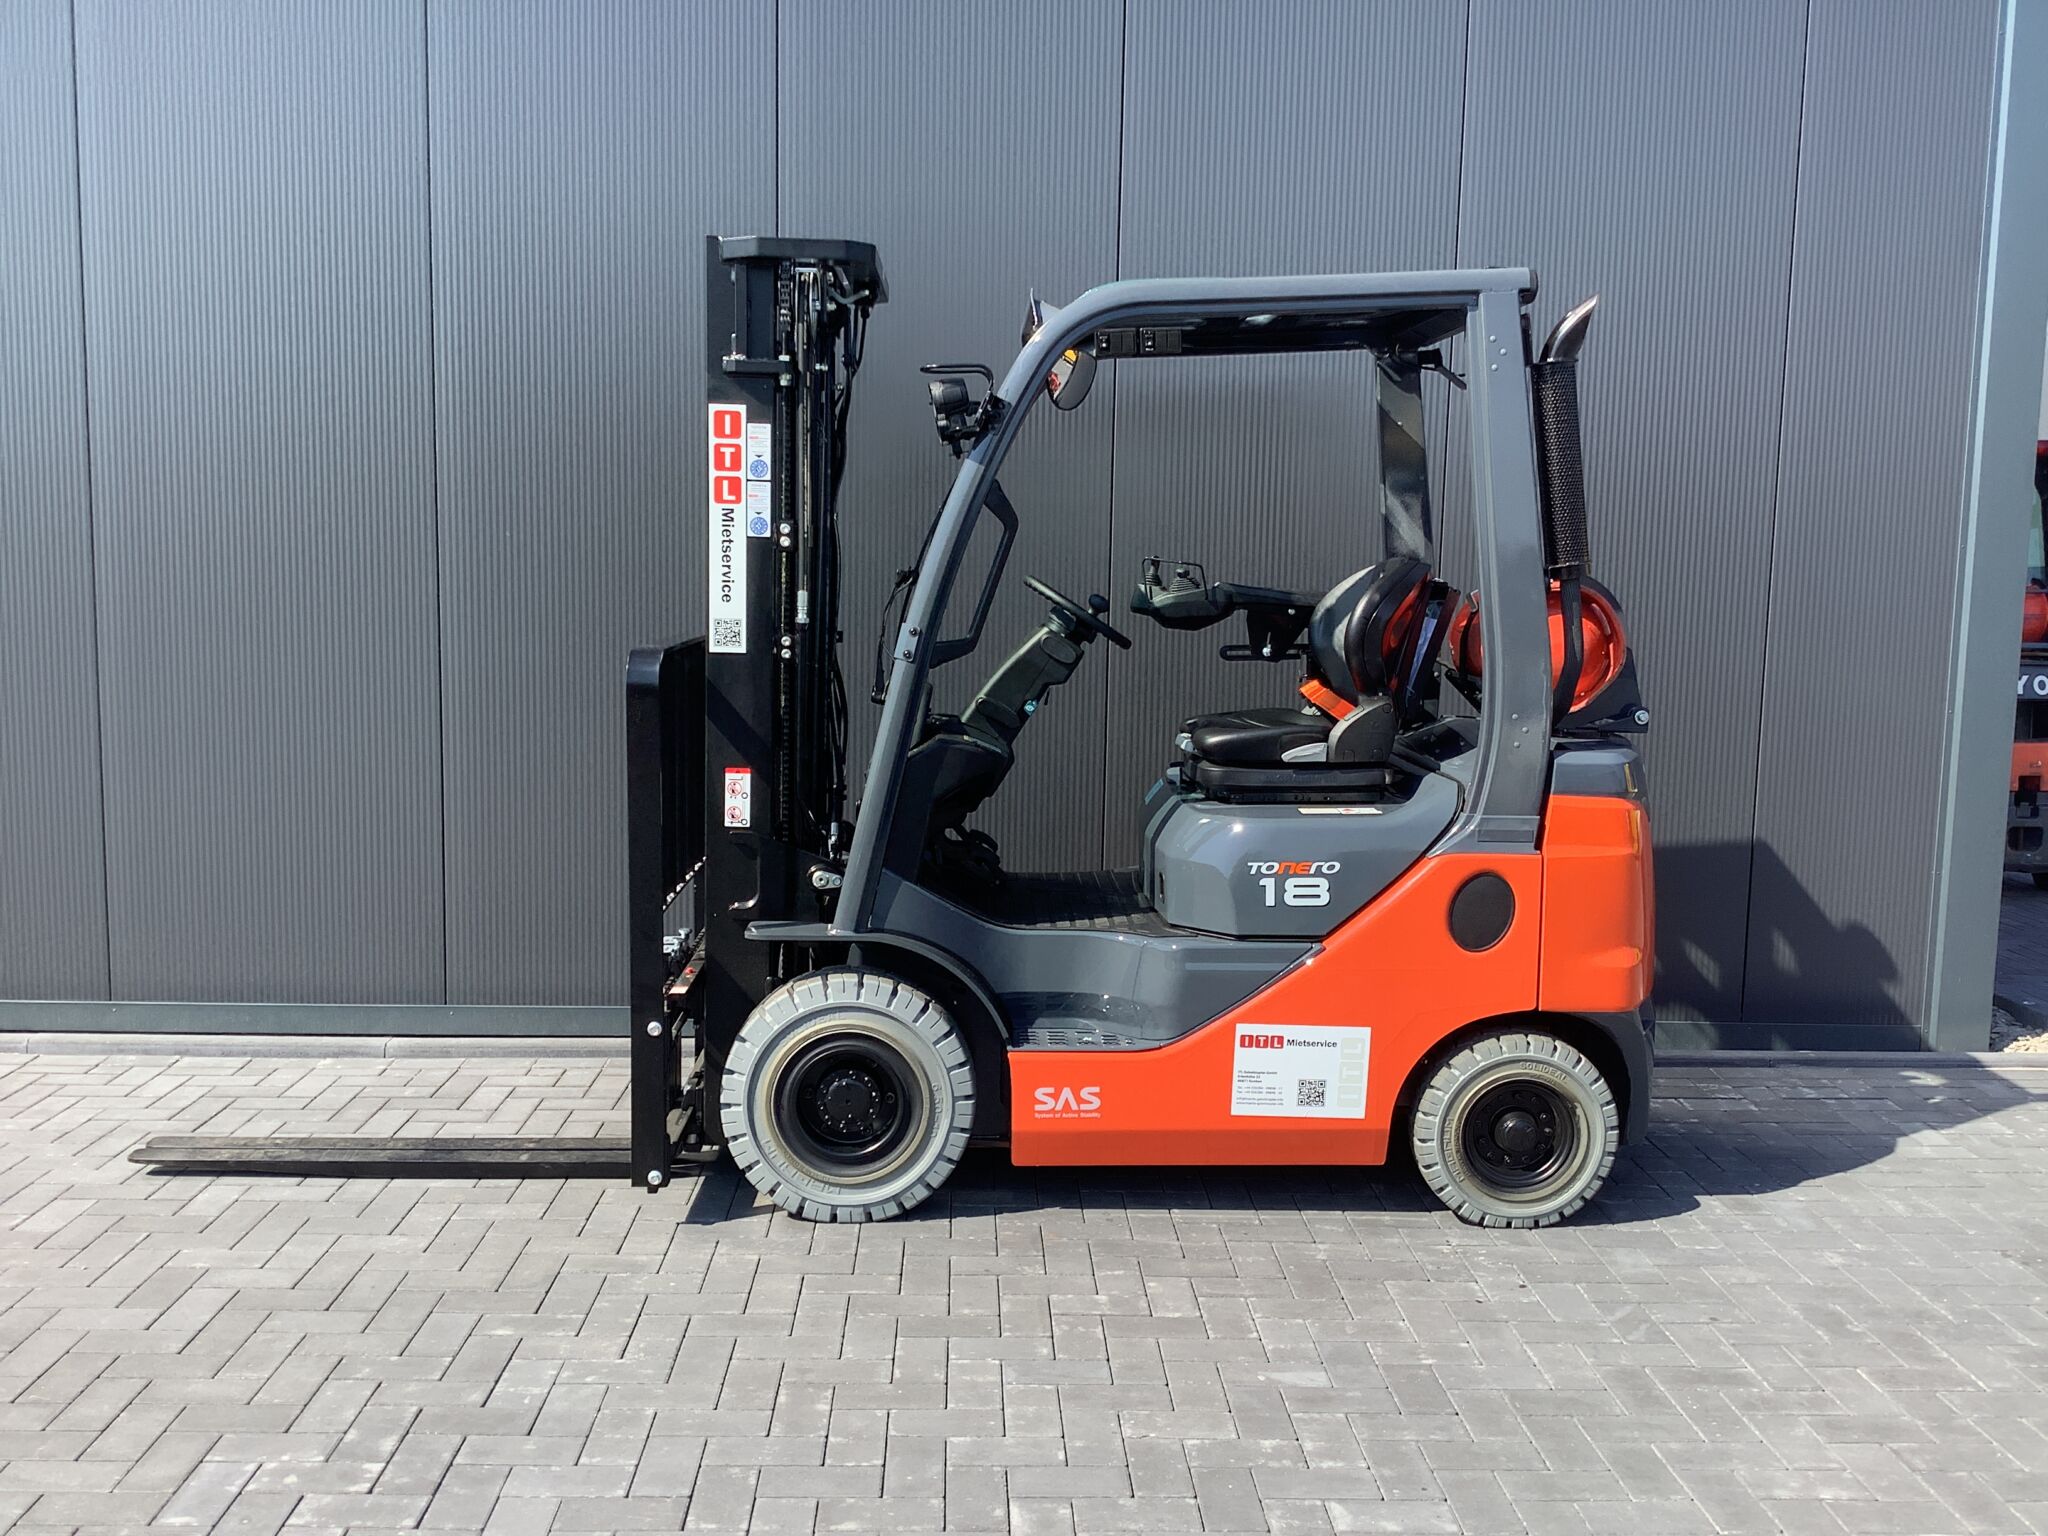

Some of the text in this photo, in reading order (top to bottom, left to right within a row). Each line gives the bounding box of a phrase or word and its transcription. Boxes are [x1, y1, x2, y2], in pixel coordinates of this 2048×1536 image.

[716, 411, 739, 603] ITL Mietservice
[1259, 877, 1330, 907] 18
[1240, 1035, 1338, 1049] ITL Mietservice
[1034, 1086, 1102, 1111] SAS
